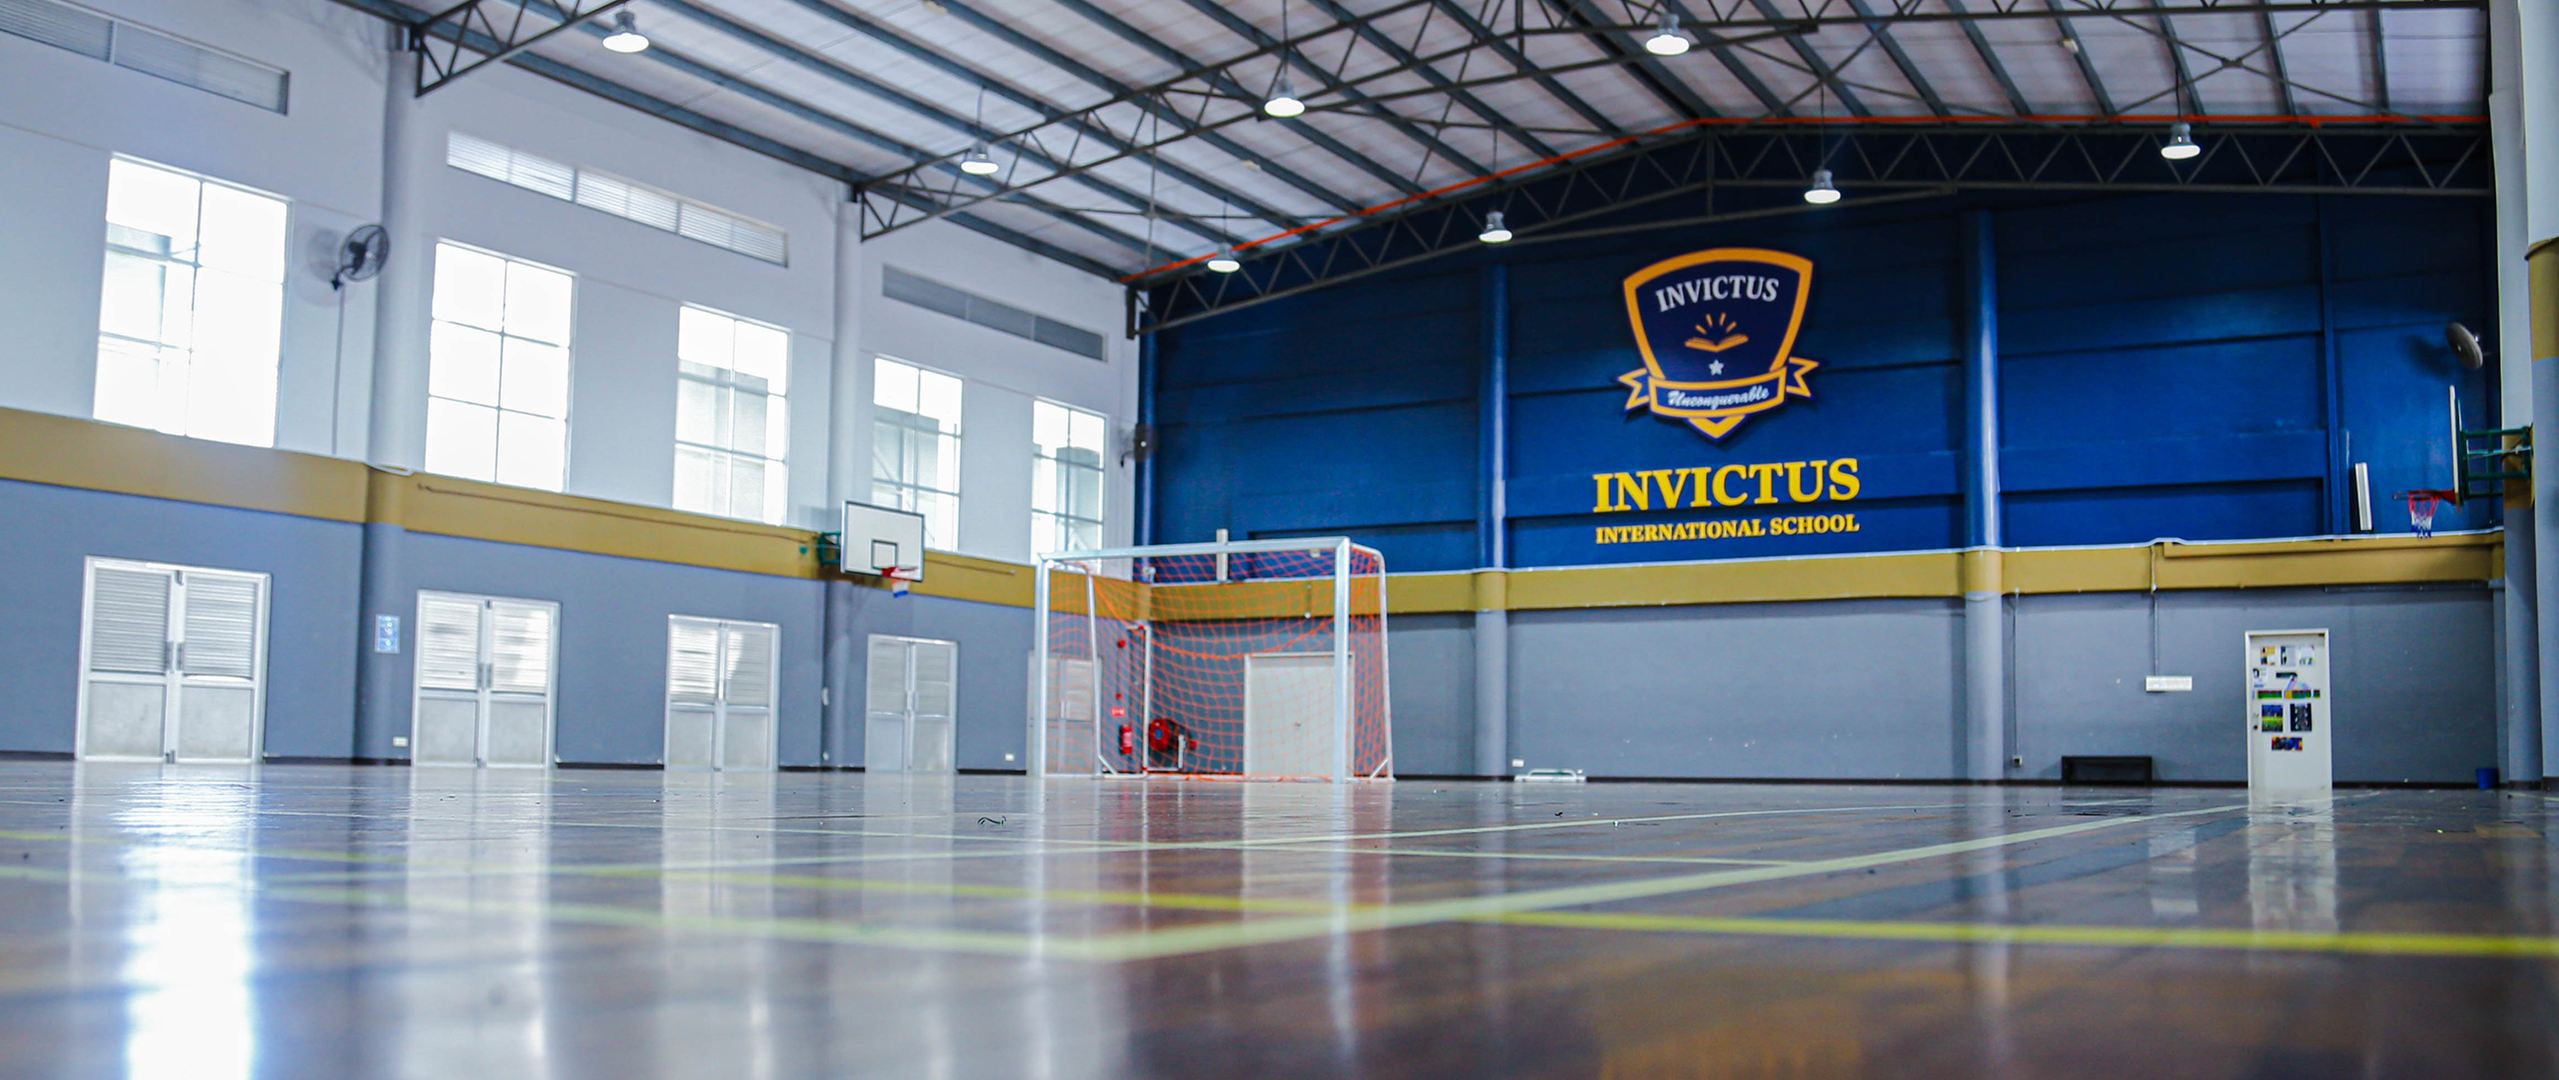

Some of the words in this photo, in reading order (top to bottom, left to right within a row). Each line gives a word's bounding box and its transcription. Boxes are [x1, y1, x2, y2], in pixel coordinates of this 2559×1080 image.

[1656, 275, 1779, 312] INVICTUS
[1668, 386, 1769, 409] Unconquerable
[1593, 458, 1860, 512] INVICTUS
[1596, 519, 1765, 543] INTERNATIONAL
[1770, 514, 1859, 535] SCHOOL
